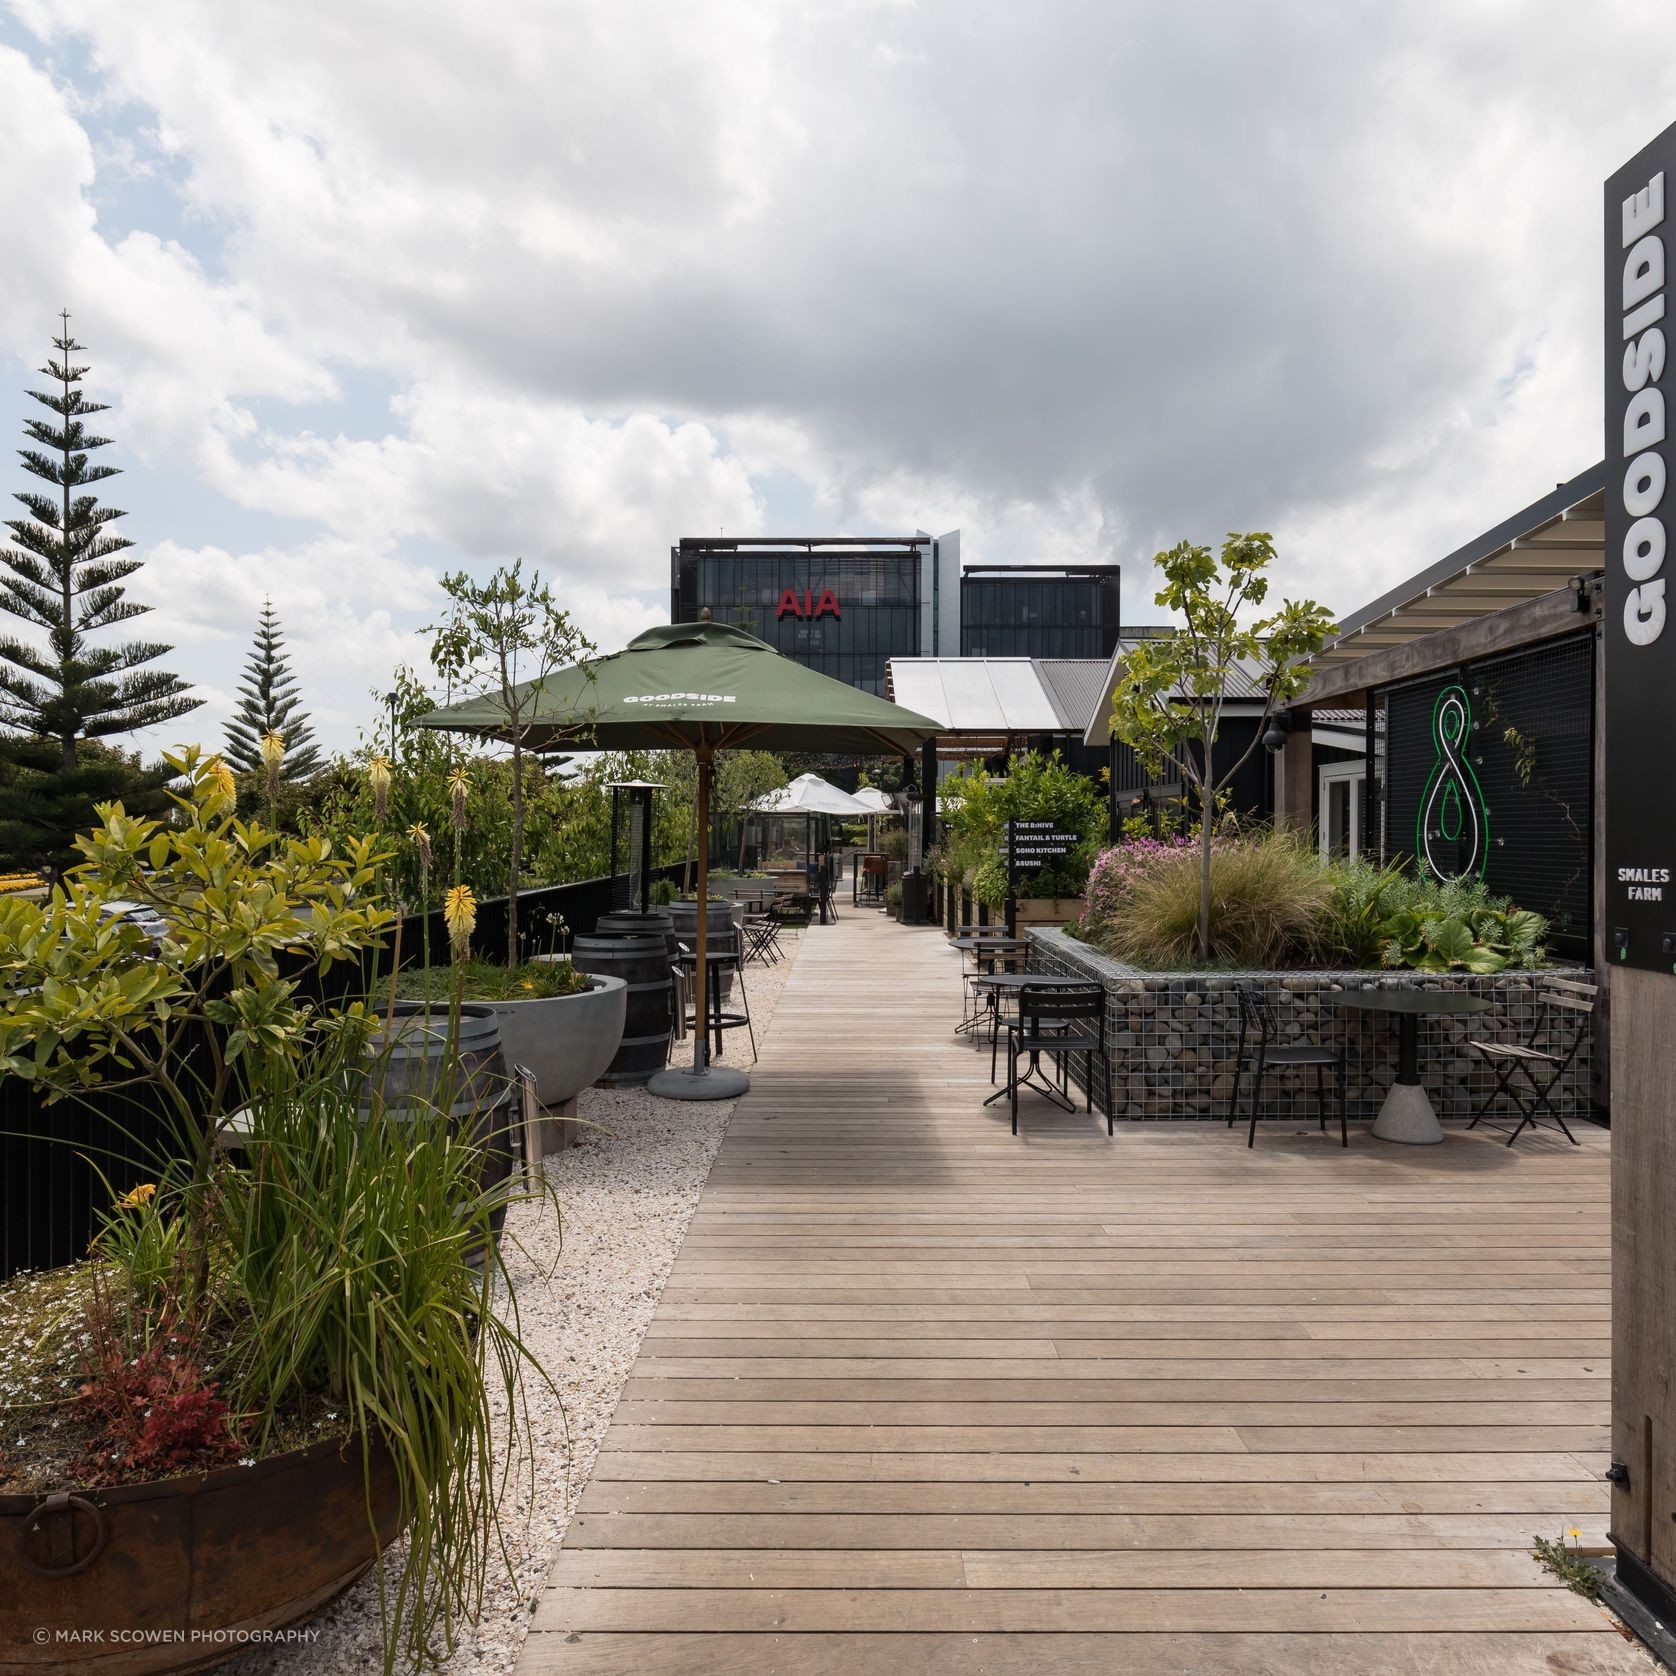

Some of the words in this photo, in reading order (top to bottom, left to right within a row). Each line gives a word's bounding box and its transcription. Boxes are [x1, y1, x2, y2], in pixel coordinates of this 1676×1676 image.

[1623, 171, 1667, 647] GOODSIDE
[775, 587, 843, 617] AIA
[623, 692, 737, 703] GOODSIDE
[1618, 867, 1670, 882] SMALES
[1628, 886, 1662, 901] FARM
